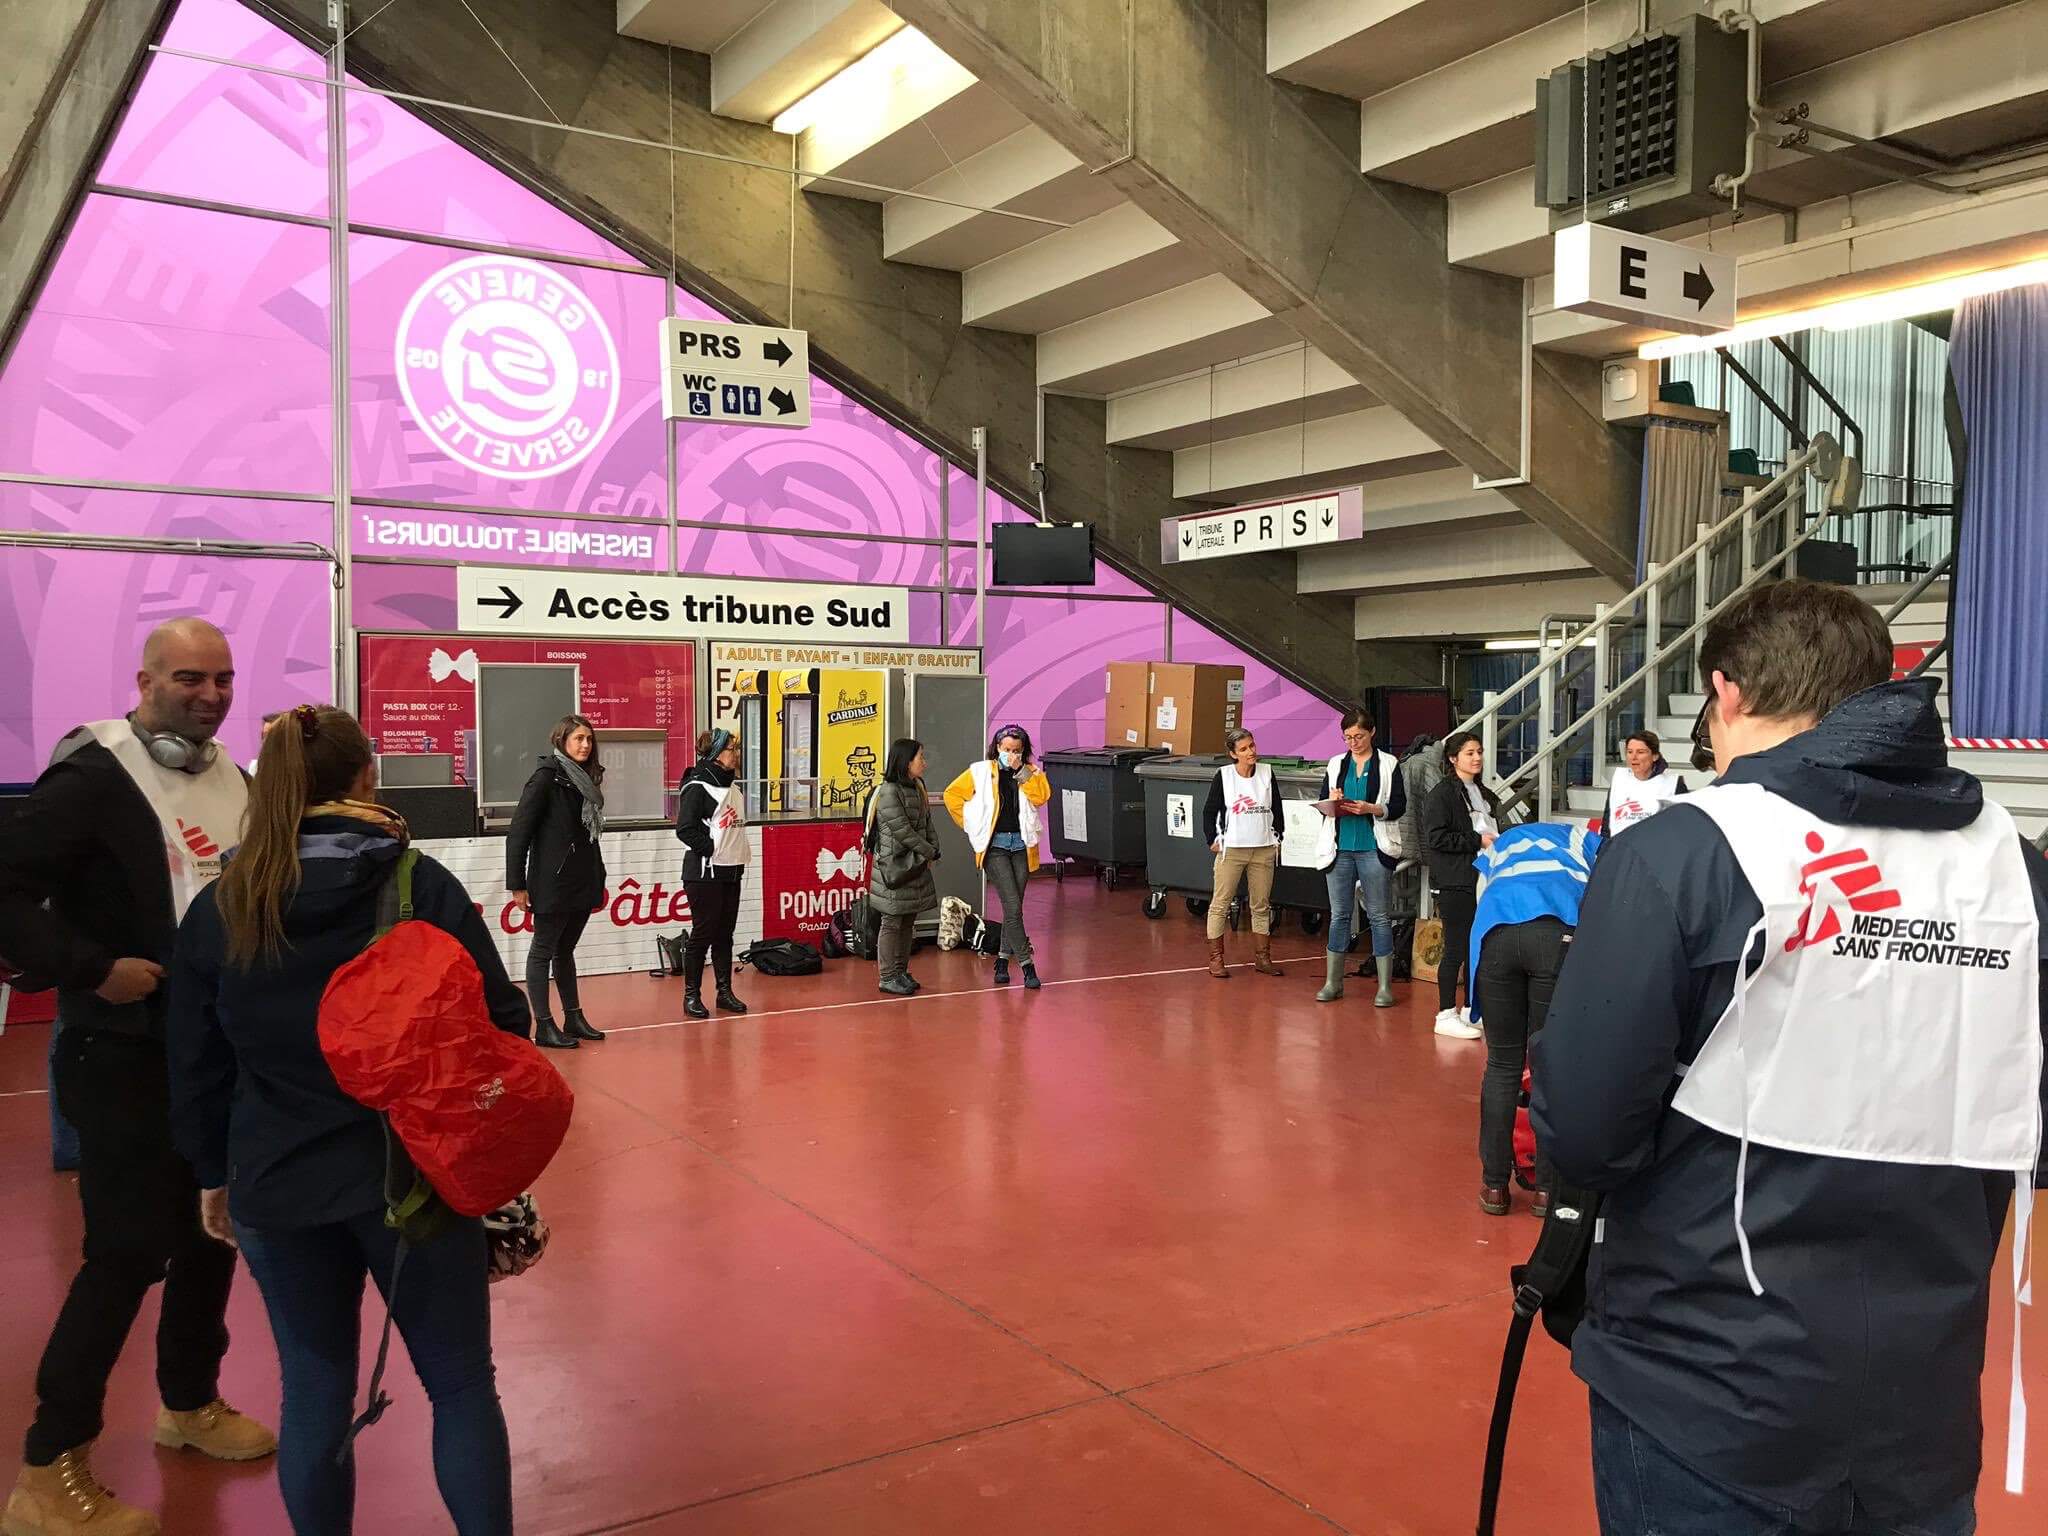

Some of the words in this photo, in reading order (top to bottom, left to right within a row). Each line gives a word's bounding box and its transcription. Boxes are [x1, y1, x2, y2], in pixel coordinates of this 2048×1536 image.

[1620, 245, 1647, 300] E
[679, 331, 742, 359] PRS
[682, 373, 717, 392] WC
[1199, 523, 1223, 536] TRIBUNE
[1197, 536, 1225, 550] LATERALE
[547, 587, 670, 621] Accès
[682, 593, 815, 626] tribune
[826, 598, 891, 629] Sud
[546, 651, 588, 660] BOISSONS
[716, 646, 723, 661] 1
[727, 648, 783, 663] ADULTE
[787, 651, 840, 664] PAYANT
[853, 651, 859, 664] 1
[863, 652, 914, 666] ENFANT
[383, 703, 408, 711] PASTA
[410, 703, 427, 711] BOX
[429, 703, 446, 711] CHF
[830, 705, 876, 722] CARDINAL
[383, 713, 407, 721] Sauce
[421, 713, 441, 721] choix
[1851, 914, 1957, 942] MEDECINS
[1832, 935, 1881, 960] SANS
